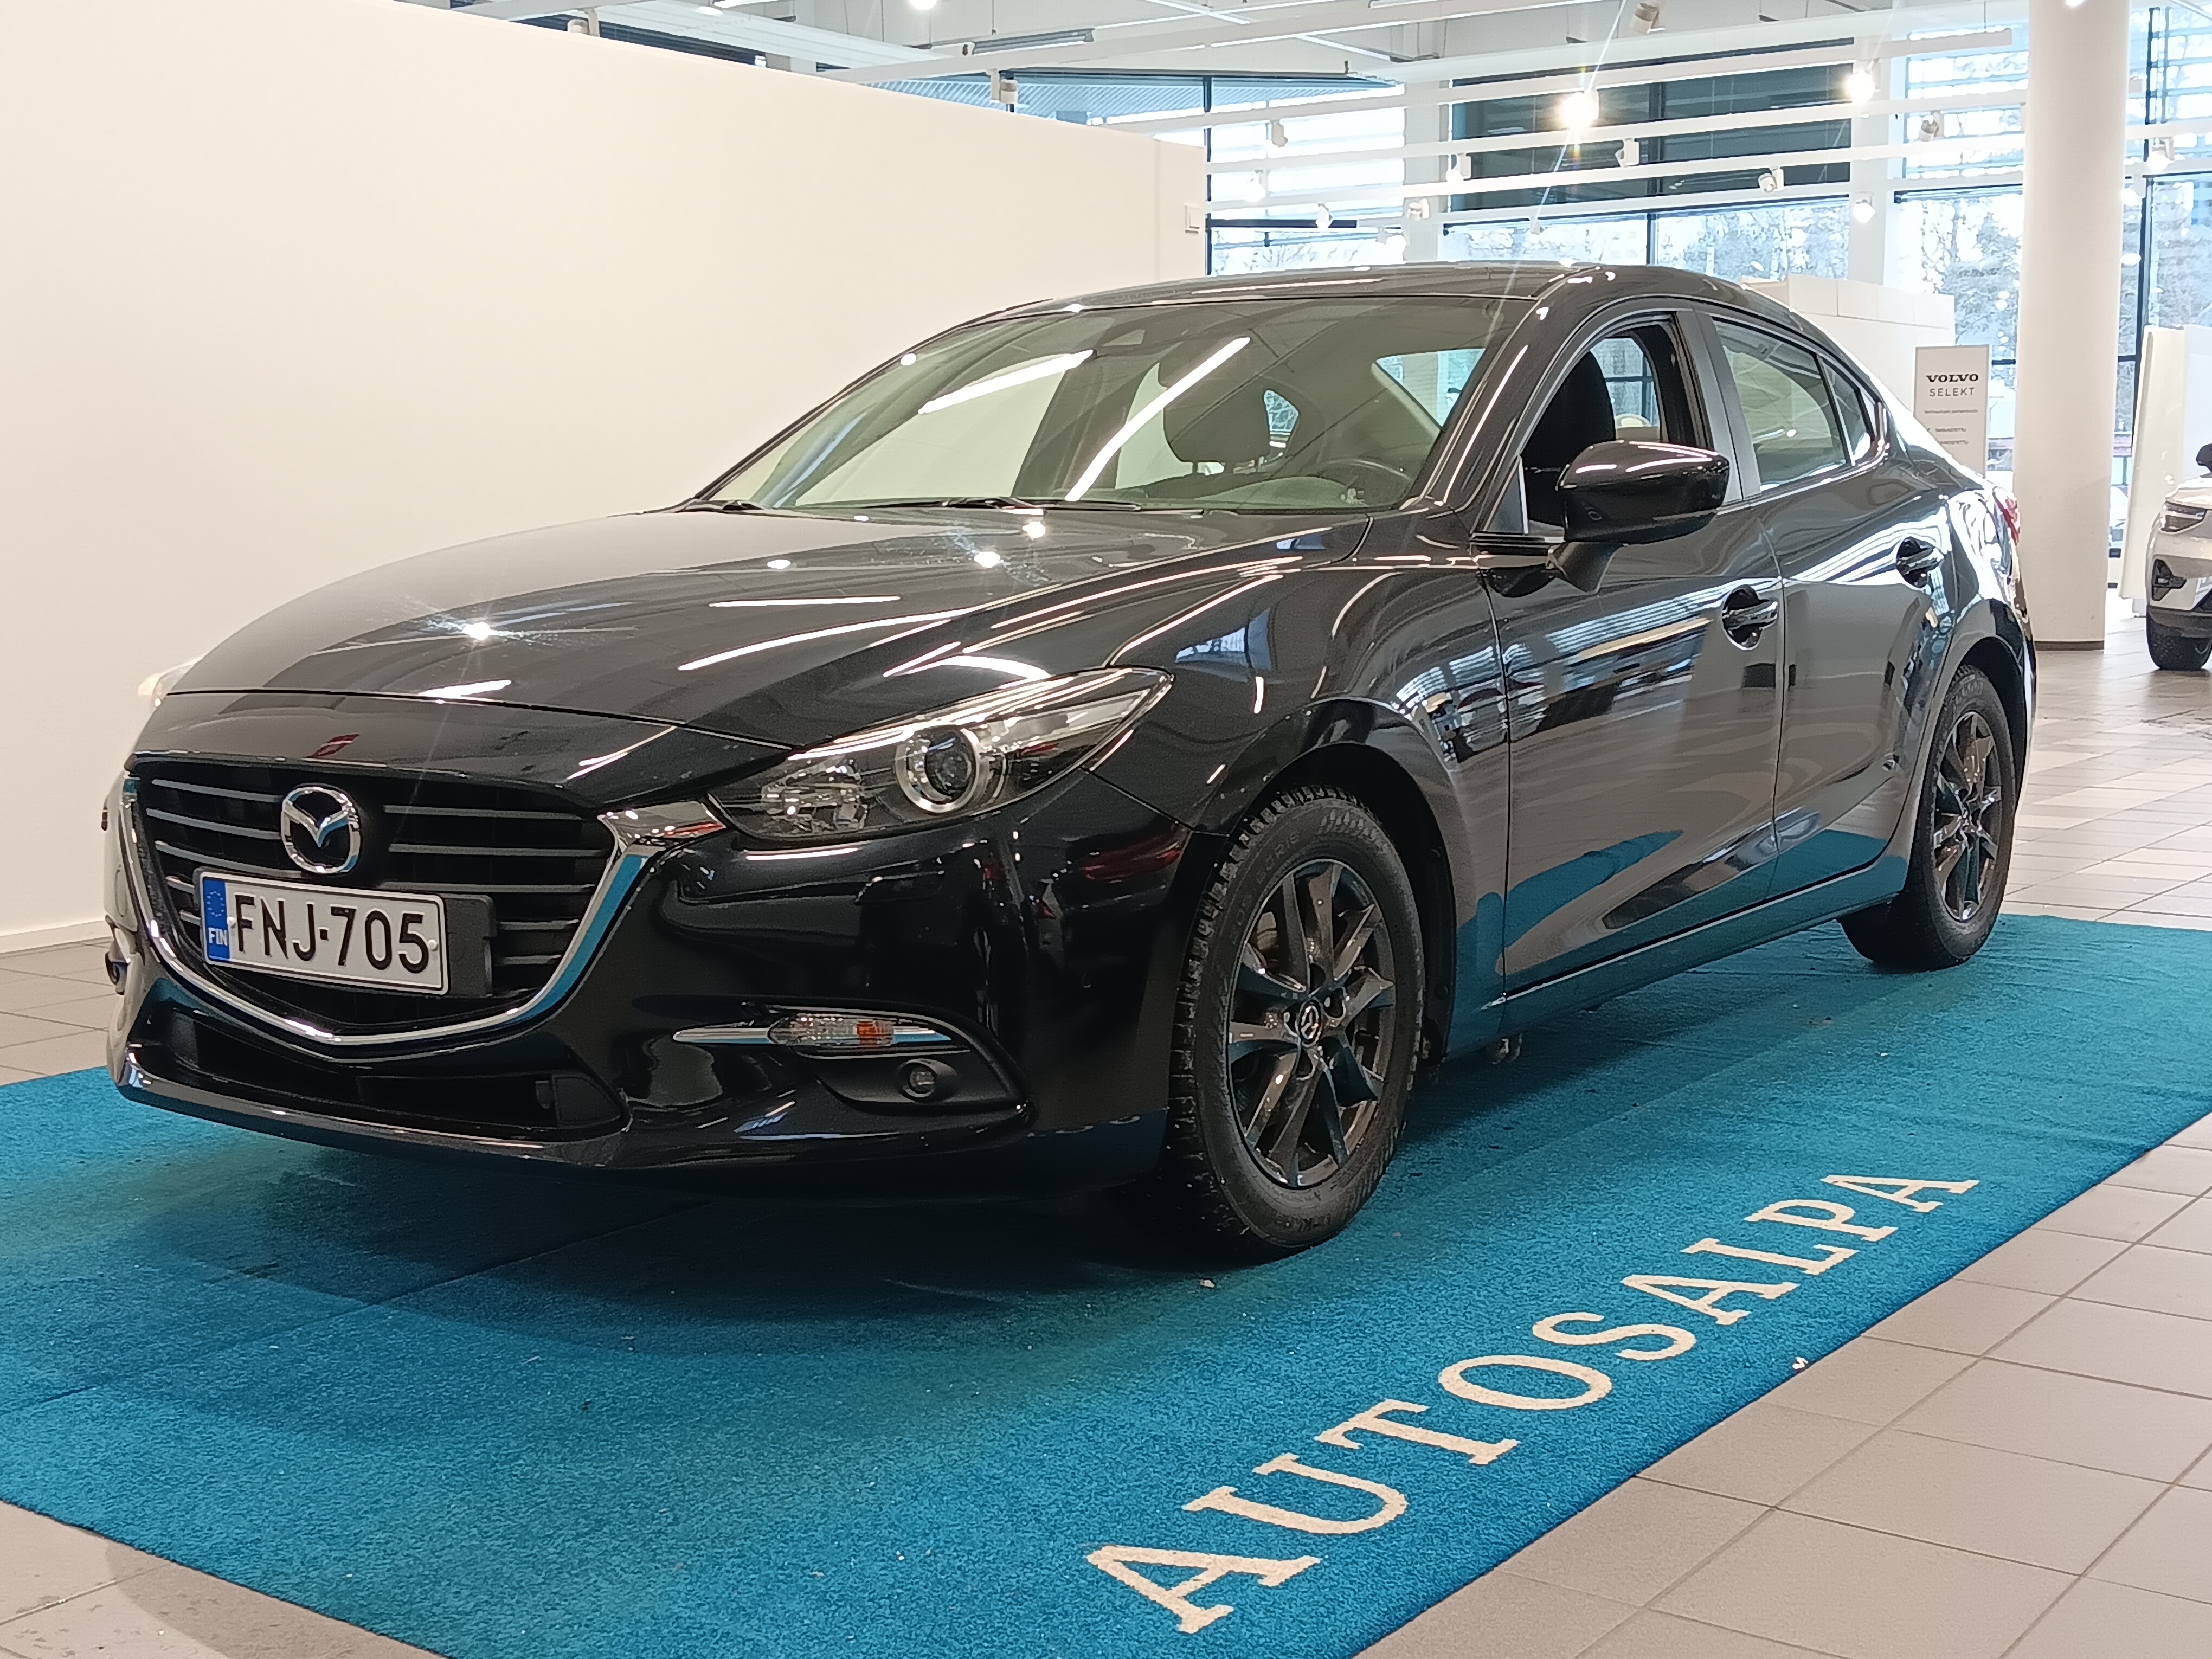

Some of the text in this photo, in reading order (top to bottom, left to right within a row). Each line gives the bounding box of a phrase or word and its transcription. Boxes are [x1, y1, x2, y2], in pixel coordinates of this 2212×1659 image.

[1926, 374, 1979, 383] VOLVO
[1929, 387, 1975, 397] SELEKT
[208, 927, 228, 946] FIN
[234, 892, 429, 974] FNJ-705
[1086, 1174, 1980, 1634] AUTOSALPA
